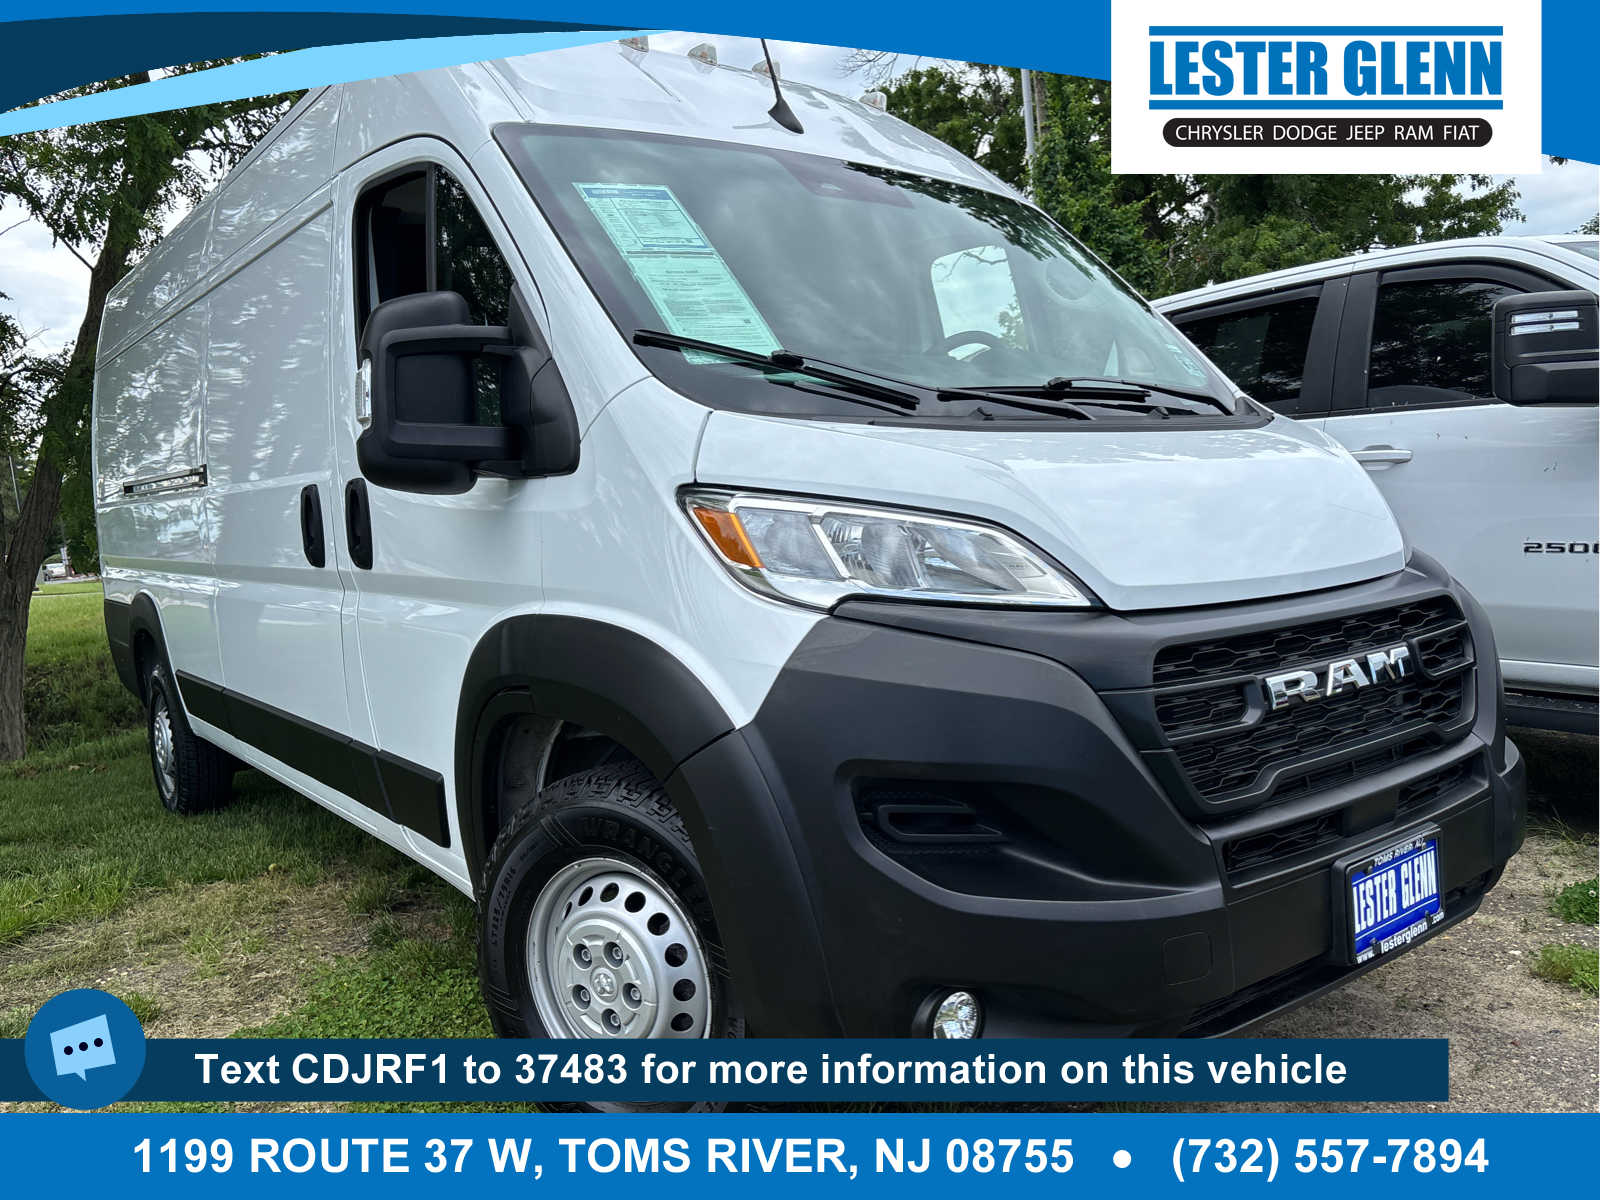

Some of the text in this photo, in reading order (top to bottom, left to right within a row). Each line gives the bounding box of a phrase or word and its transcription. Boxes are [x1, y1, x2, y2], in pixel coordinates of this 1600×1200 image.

[1266, 645, 1410, 711] RAM
[1373, 850, 1394, 867] TOMS
[1394, 843, 1414, 859] RIVER
[1352, 849, 1437, 934] LESTER GLENN
[1380, 921, 1428, 954] lesterglenn
